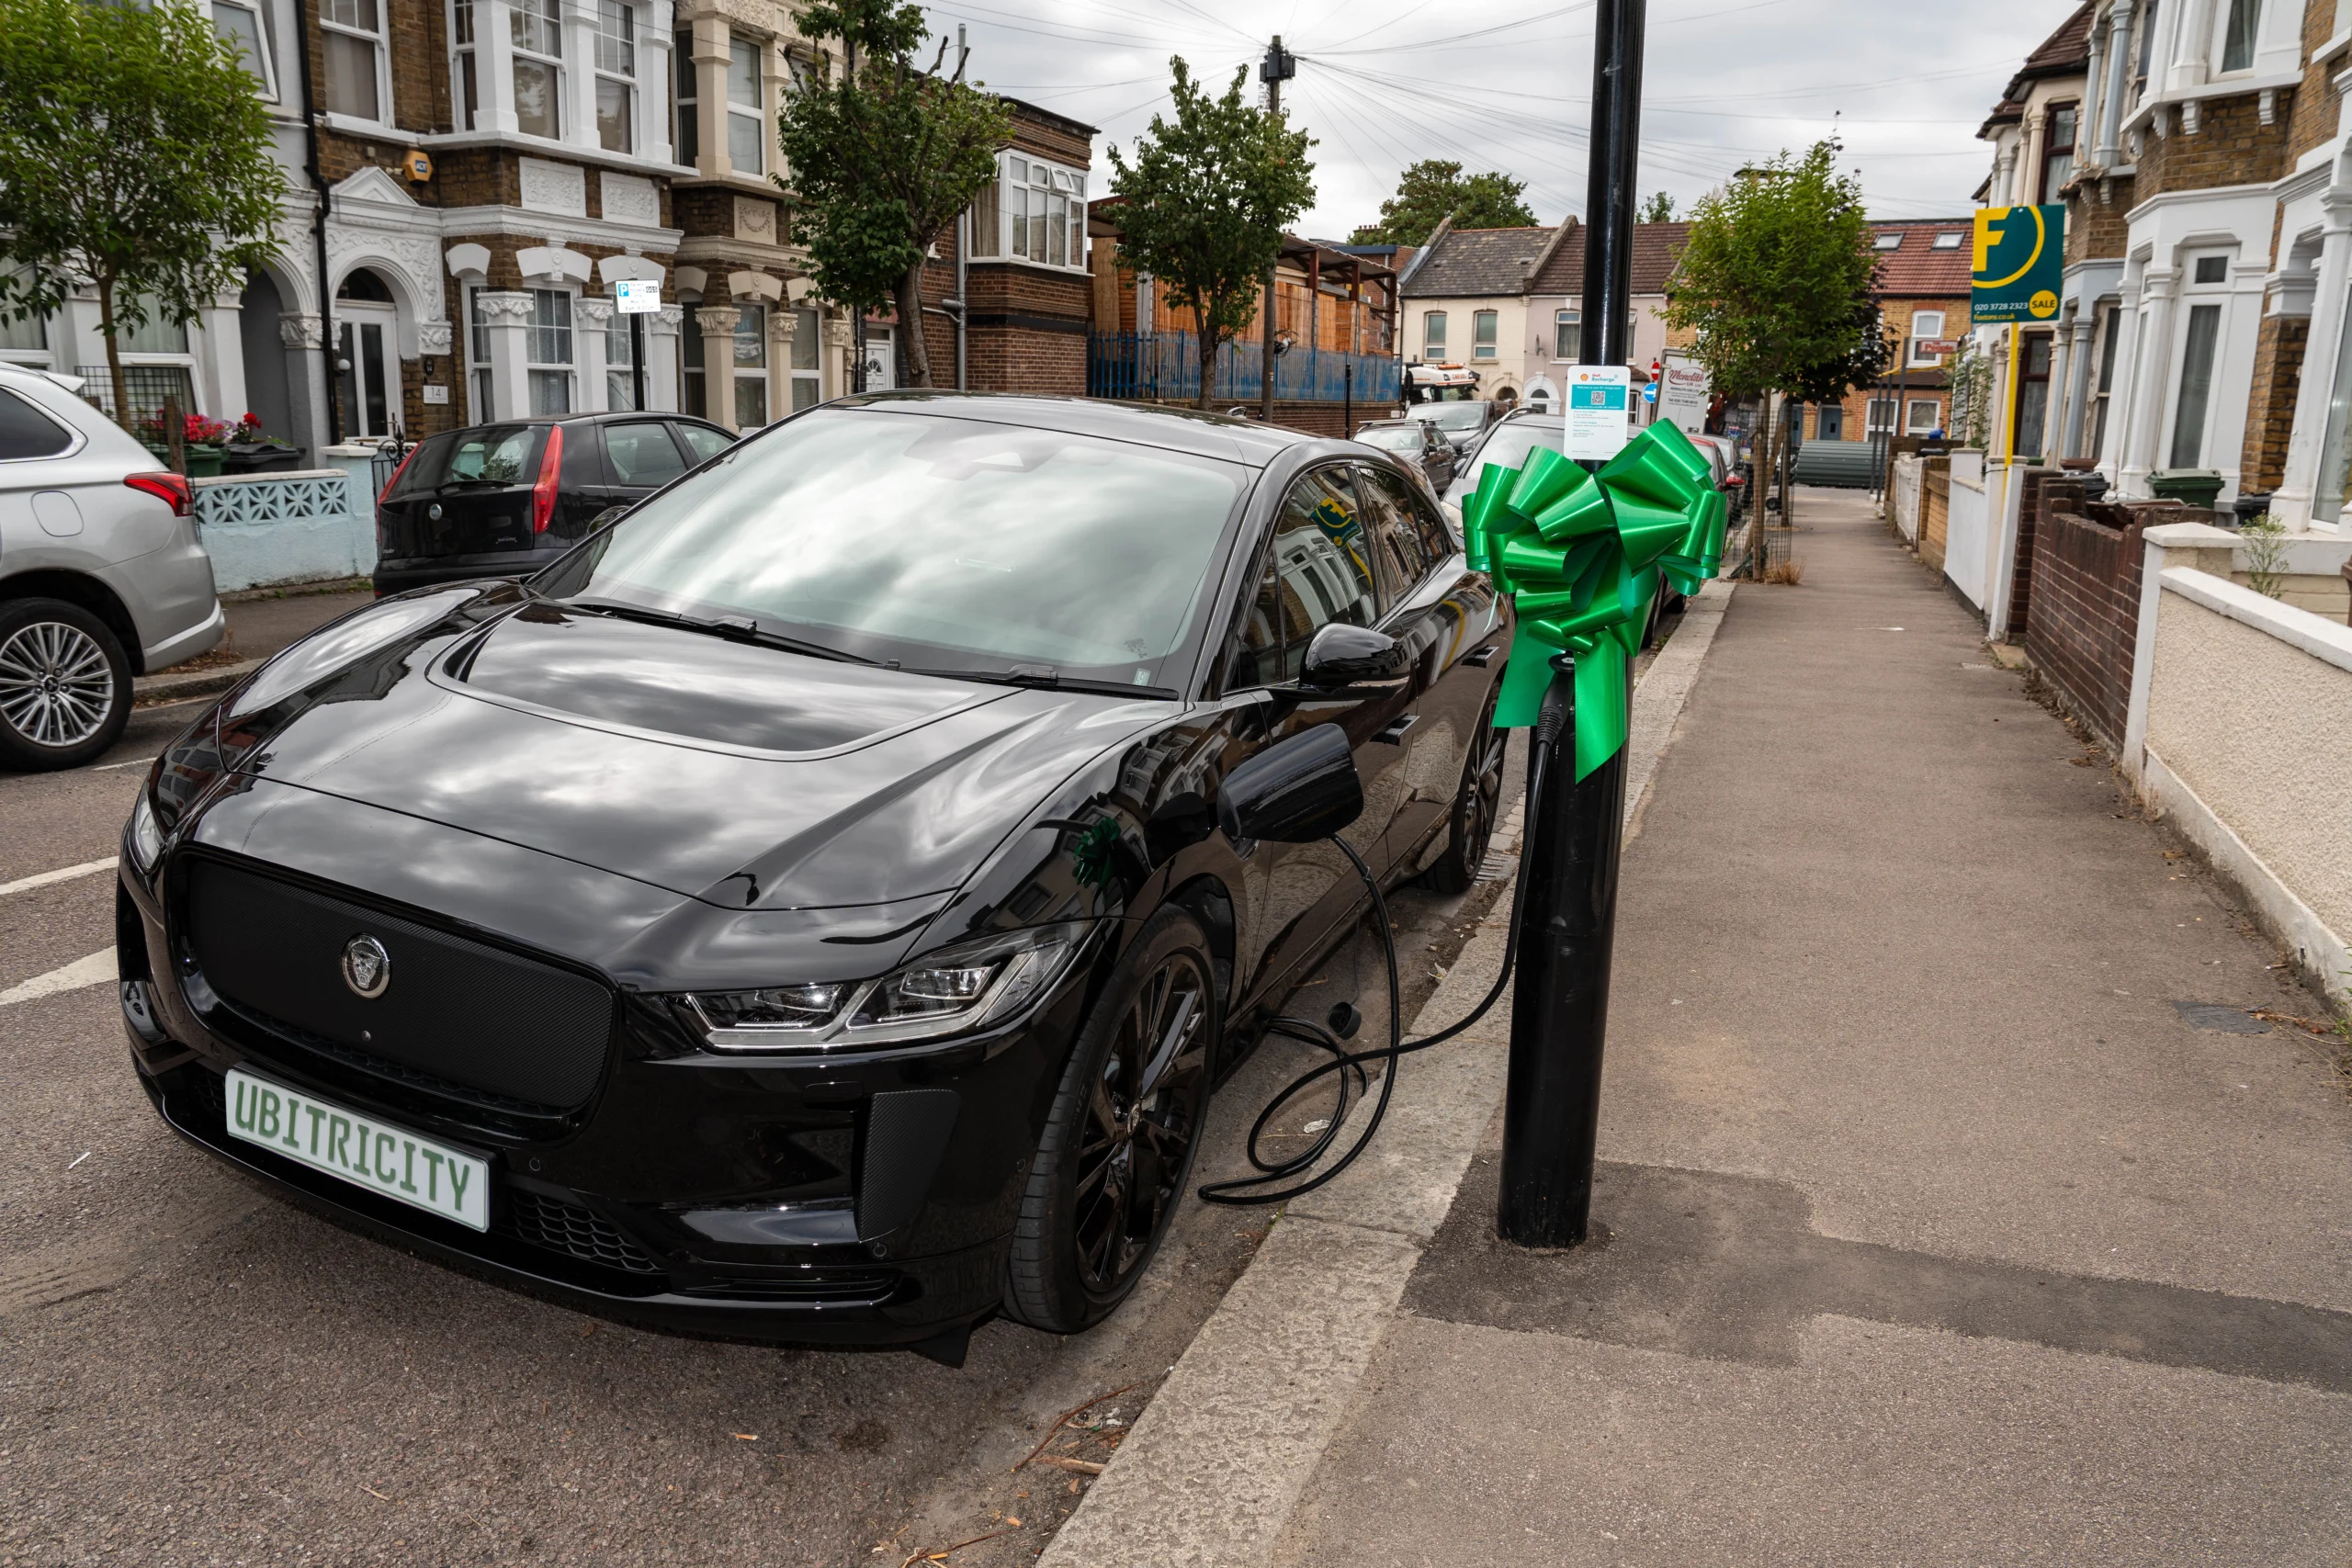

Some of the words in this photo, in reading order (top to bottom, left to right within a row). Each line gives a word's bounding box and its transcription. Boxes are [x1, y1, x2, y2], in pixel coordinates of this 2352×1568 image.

[1972, 206, 2012, 272] F
[1974, 303, 1989, 311] 020
[1989, 302, 2008, 310] 3728
[2008, 301, 2029, 310] 2323
[2031, 299, 2055, 309] SALE
[1973, 312, 2016, 321] Foxtons.co.uk
[1668, 369, 1704, 382] Monolith
[431, 387, 441, 399] 14
[235, 1080, 470, 1212] UBITRICITY
